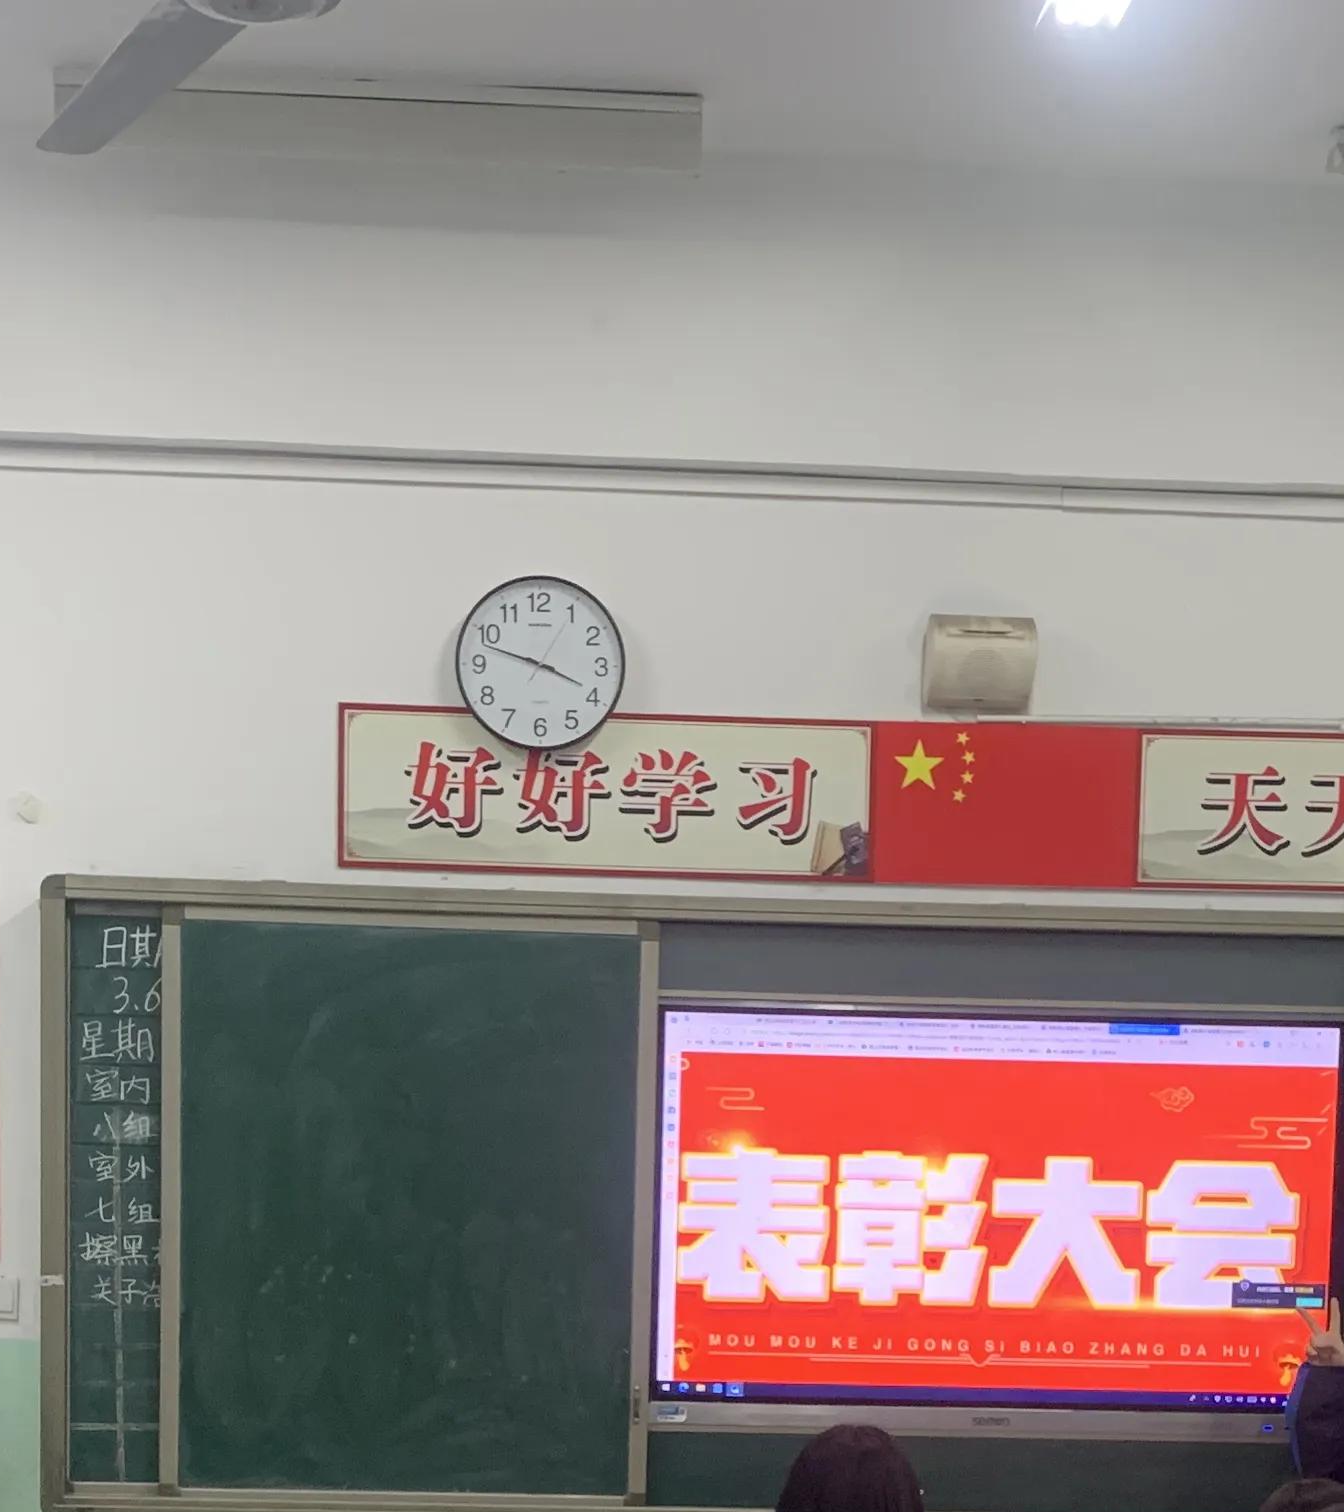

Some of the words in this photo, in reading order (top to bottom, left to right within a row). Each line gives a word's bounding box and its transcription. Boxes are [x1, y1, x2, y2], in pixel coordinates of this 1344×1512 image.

[527, 592, 551, 613] 12
[499, 603, 518, 623] 11
[566, 604, 575, 623] 1
[478, 624, 500, 644] 10
[586, 626, 600, 646] 2
[472, 654, 486, 674] 9
[594, 657, 608, 677] 3
[480, 685, 494, 705] 8
[585, 687, 600, 707] 4
[501, 708, 516, 728] 7
[534, 718, 547, 737] 6
[564, 710, 578, 729] 5
[406, 741, 817, 845] 好好学习
[80, 1017, 155, 1063] 星期
[86, 1066, 150, 1104] 室内
[678, 1148, 1299, 1309] 表彰大会
[79, 1231, 161, 1266] 擦黑
[708, 1334, 755, 1347] MOU
[770, 1335, 816, 1348] MOU
[832, 1336, 858, 1349] KE
[873, 1337, 892, 1350] JI
[907, 1338, 970, 1351] GONG
[984, 1340, 1004, 1352] SI
[1020, 1340, 1075, 1353] BIAO
[1089, 1341, 1165, 1356] ZHANG
[1180, 1343, 1207, 1356] DA
[1222, 1345, 1260, 1358] HUI
